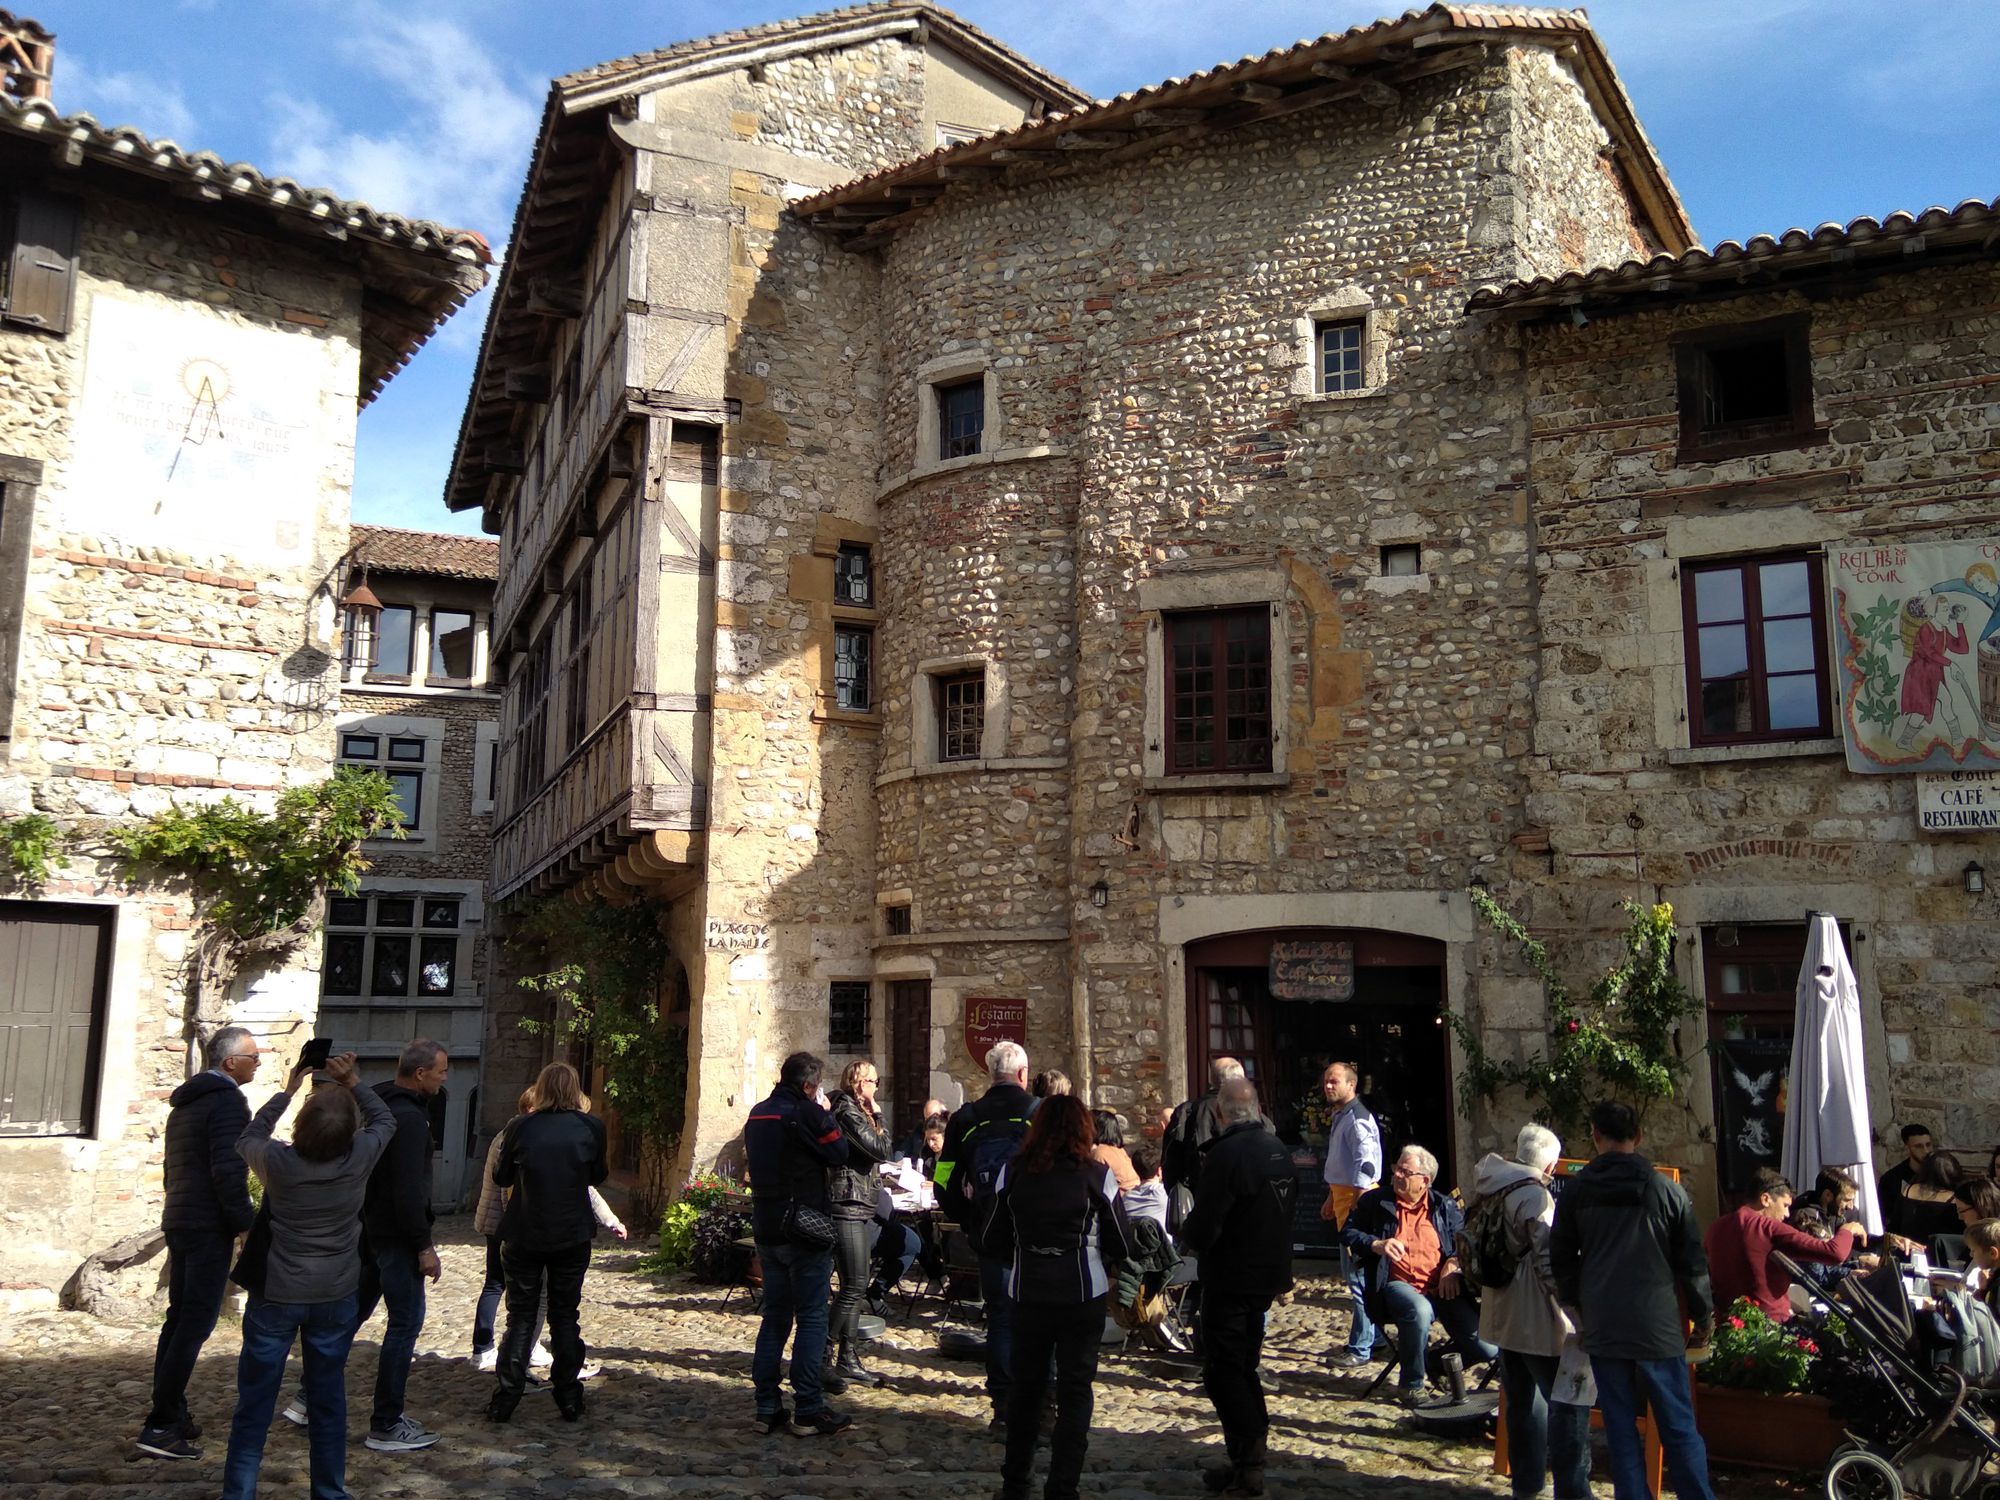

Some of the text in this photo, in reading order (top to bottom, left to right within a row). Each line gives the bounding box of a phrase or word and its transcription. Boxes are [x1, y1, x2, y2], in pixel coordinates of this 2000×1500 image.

[1941, 785, 1984, 805] CAFÉ
[709, 921, 748, 935] PLACE
[708, 937, 728, 948] LA
